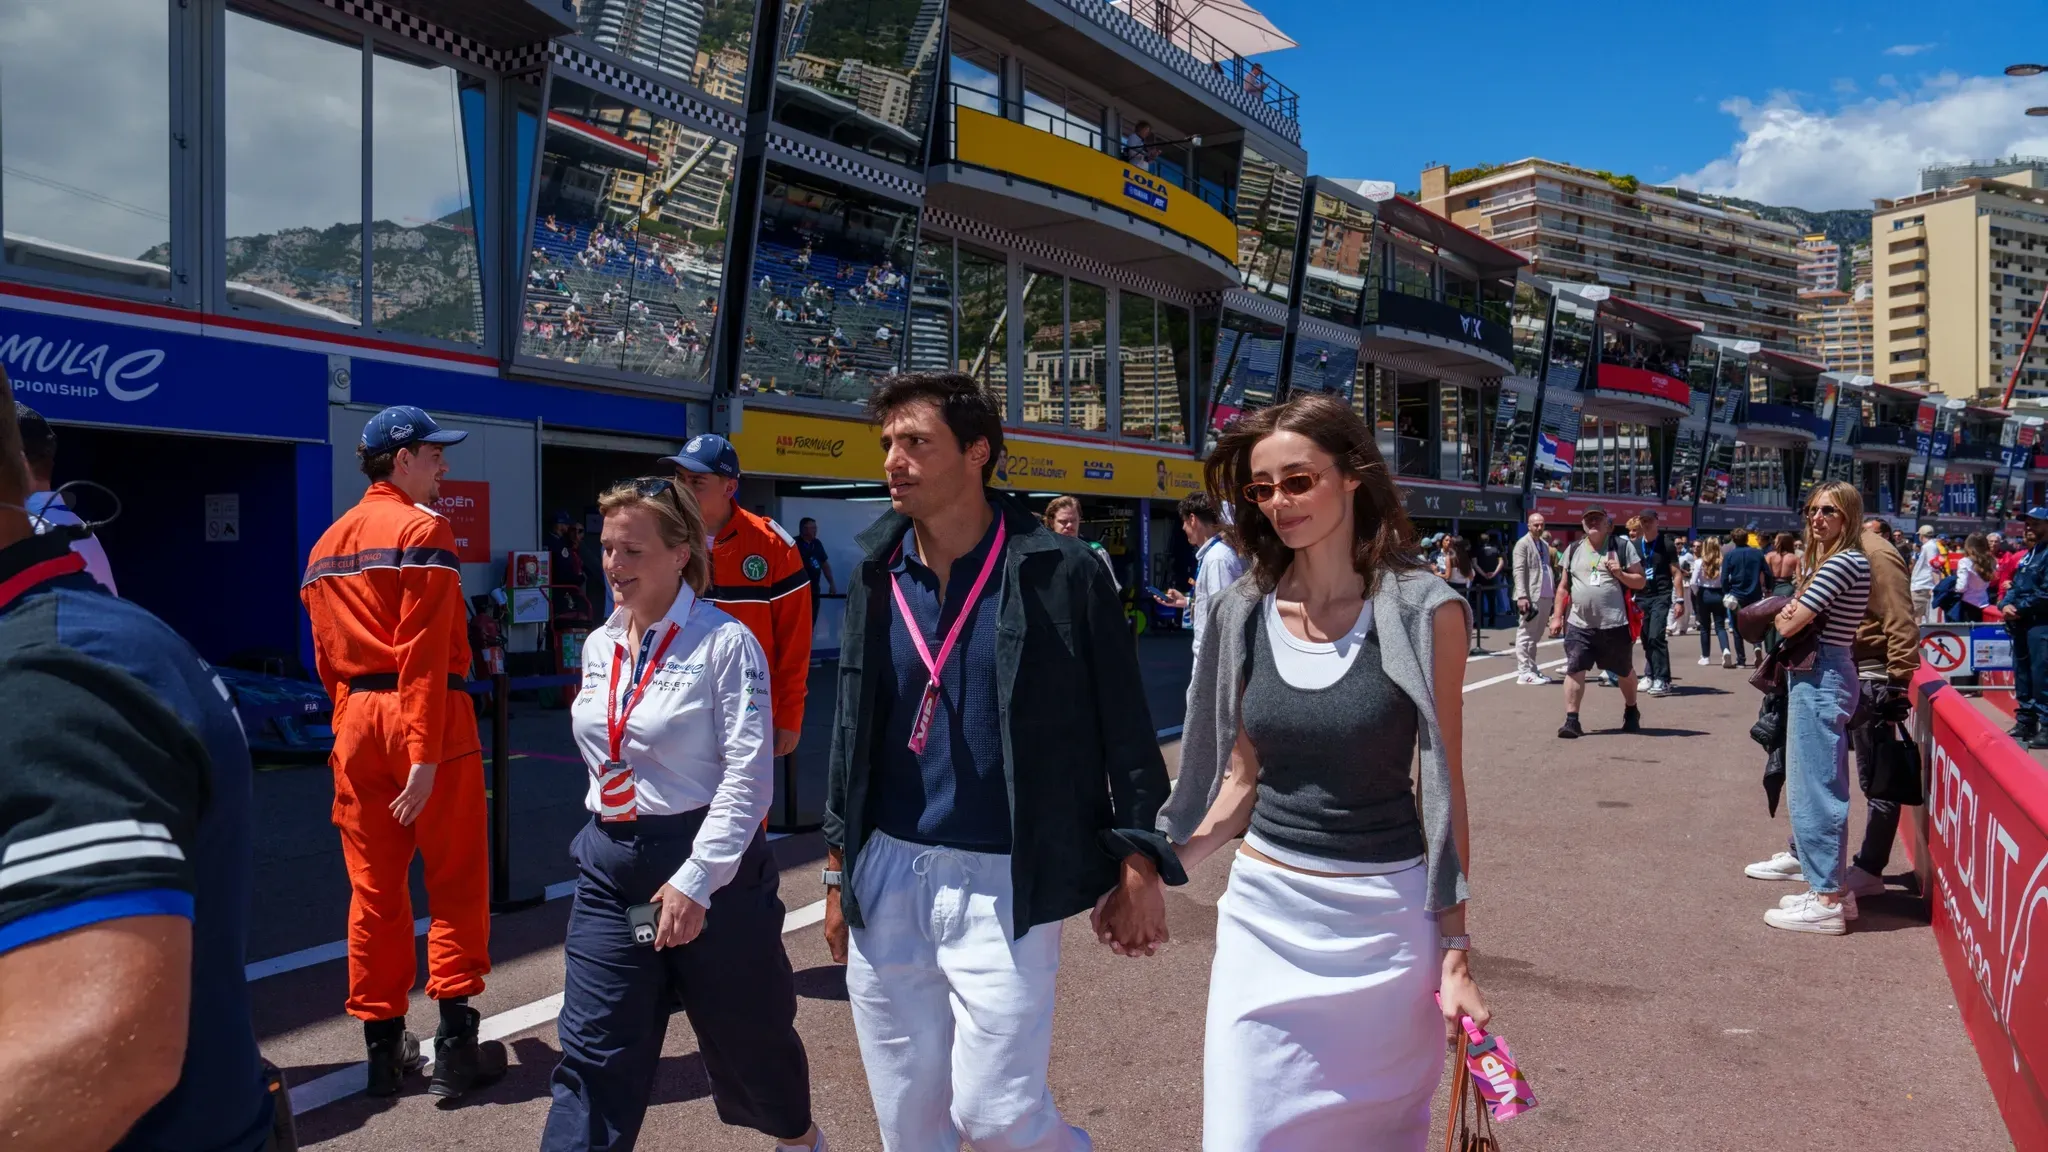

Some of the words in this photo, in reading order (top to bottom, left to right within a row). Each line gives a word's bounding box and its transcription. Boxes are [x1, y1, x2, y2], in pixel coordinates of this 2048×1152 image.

[1123, 168, 1168, 197] LOLA
[776, 435, 793, 446] ABB
[793, 436, 833, 451] FORMULA
[1008, 455, 1028, 476] 22
[1031, 467, 1067, 480] MALONEY
[1084, 460, 1114, 469] LOLA
[305, 703, 318, 711] FIA
[916, 697, 933, 739] VIP
[1933, 743, 2019, 956] CIRCUIT
[1481, 1055, 1518, 1107] VIP
